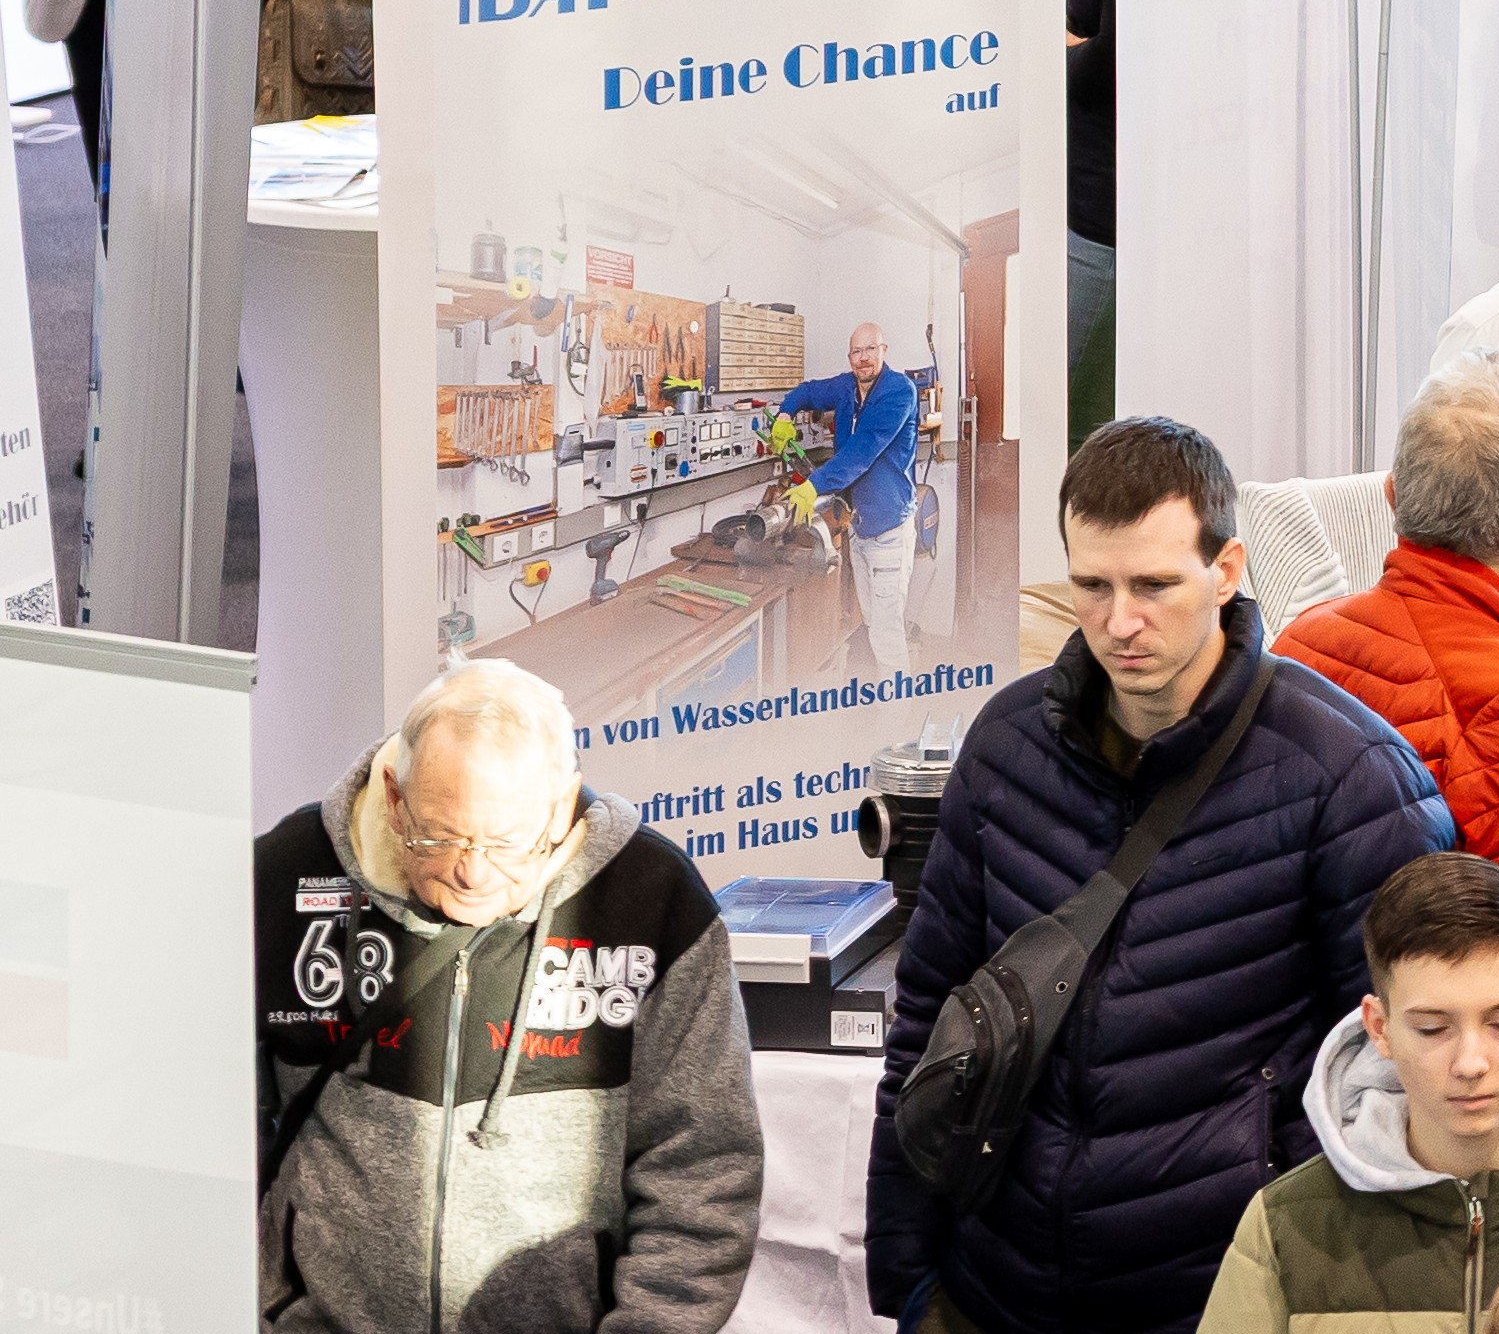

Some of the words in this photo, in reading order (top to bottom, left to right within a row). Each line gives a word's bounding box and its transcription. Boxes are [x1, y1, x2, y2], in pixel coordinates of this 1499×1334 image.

[604, 51, 768, 111] Deine
[783, 31, 999, 91] Chance
[945, 83, 1002, 114] auf
[604, 717, 659, 745] von
[672, 662, 993, 734] Wasserlandschaften
[302, 896, 338, 907] ROAD
[534, 945, 656, 988] CAMB
